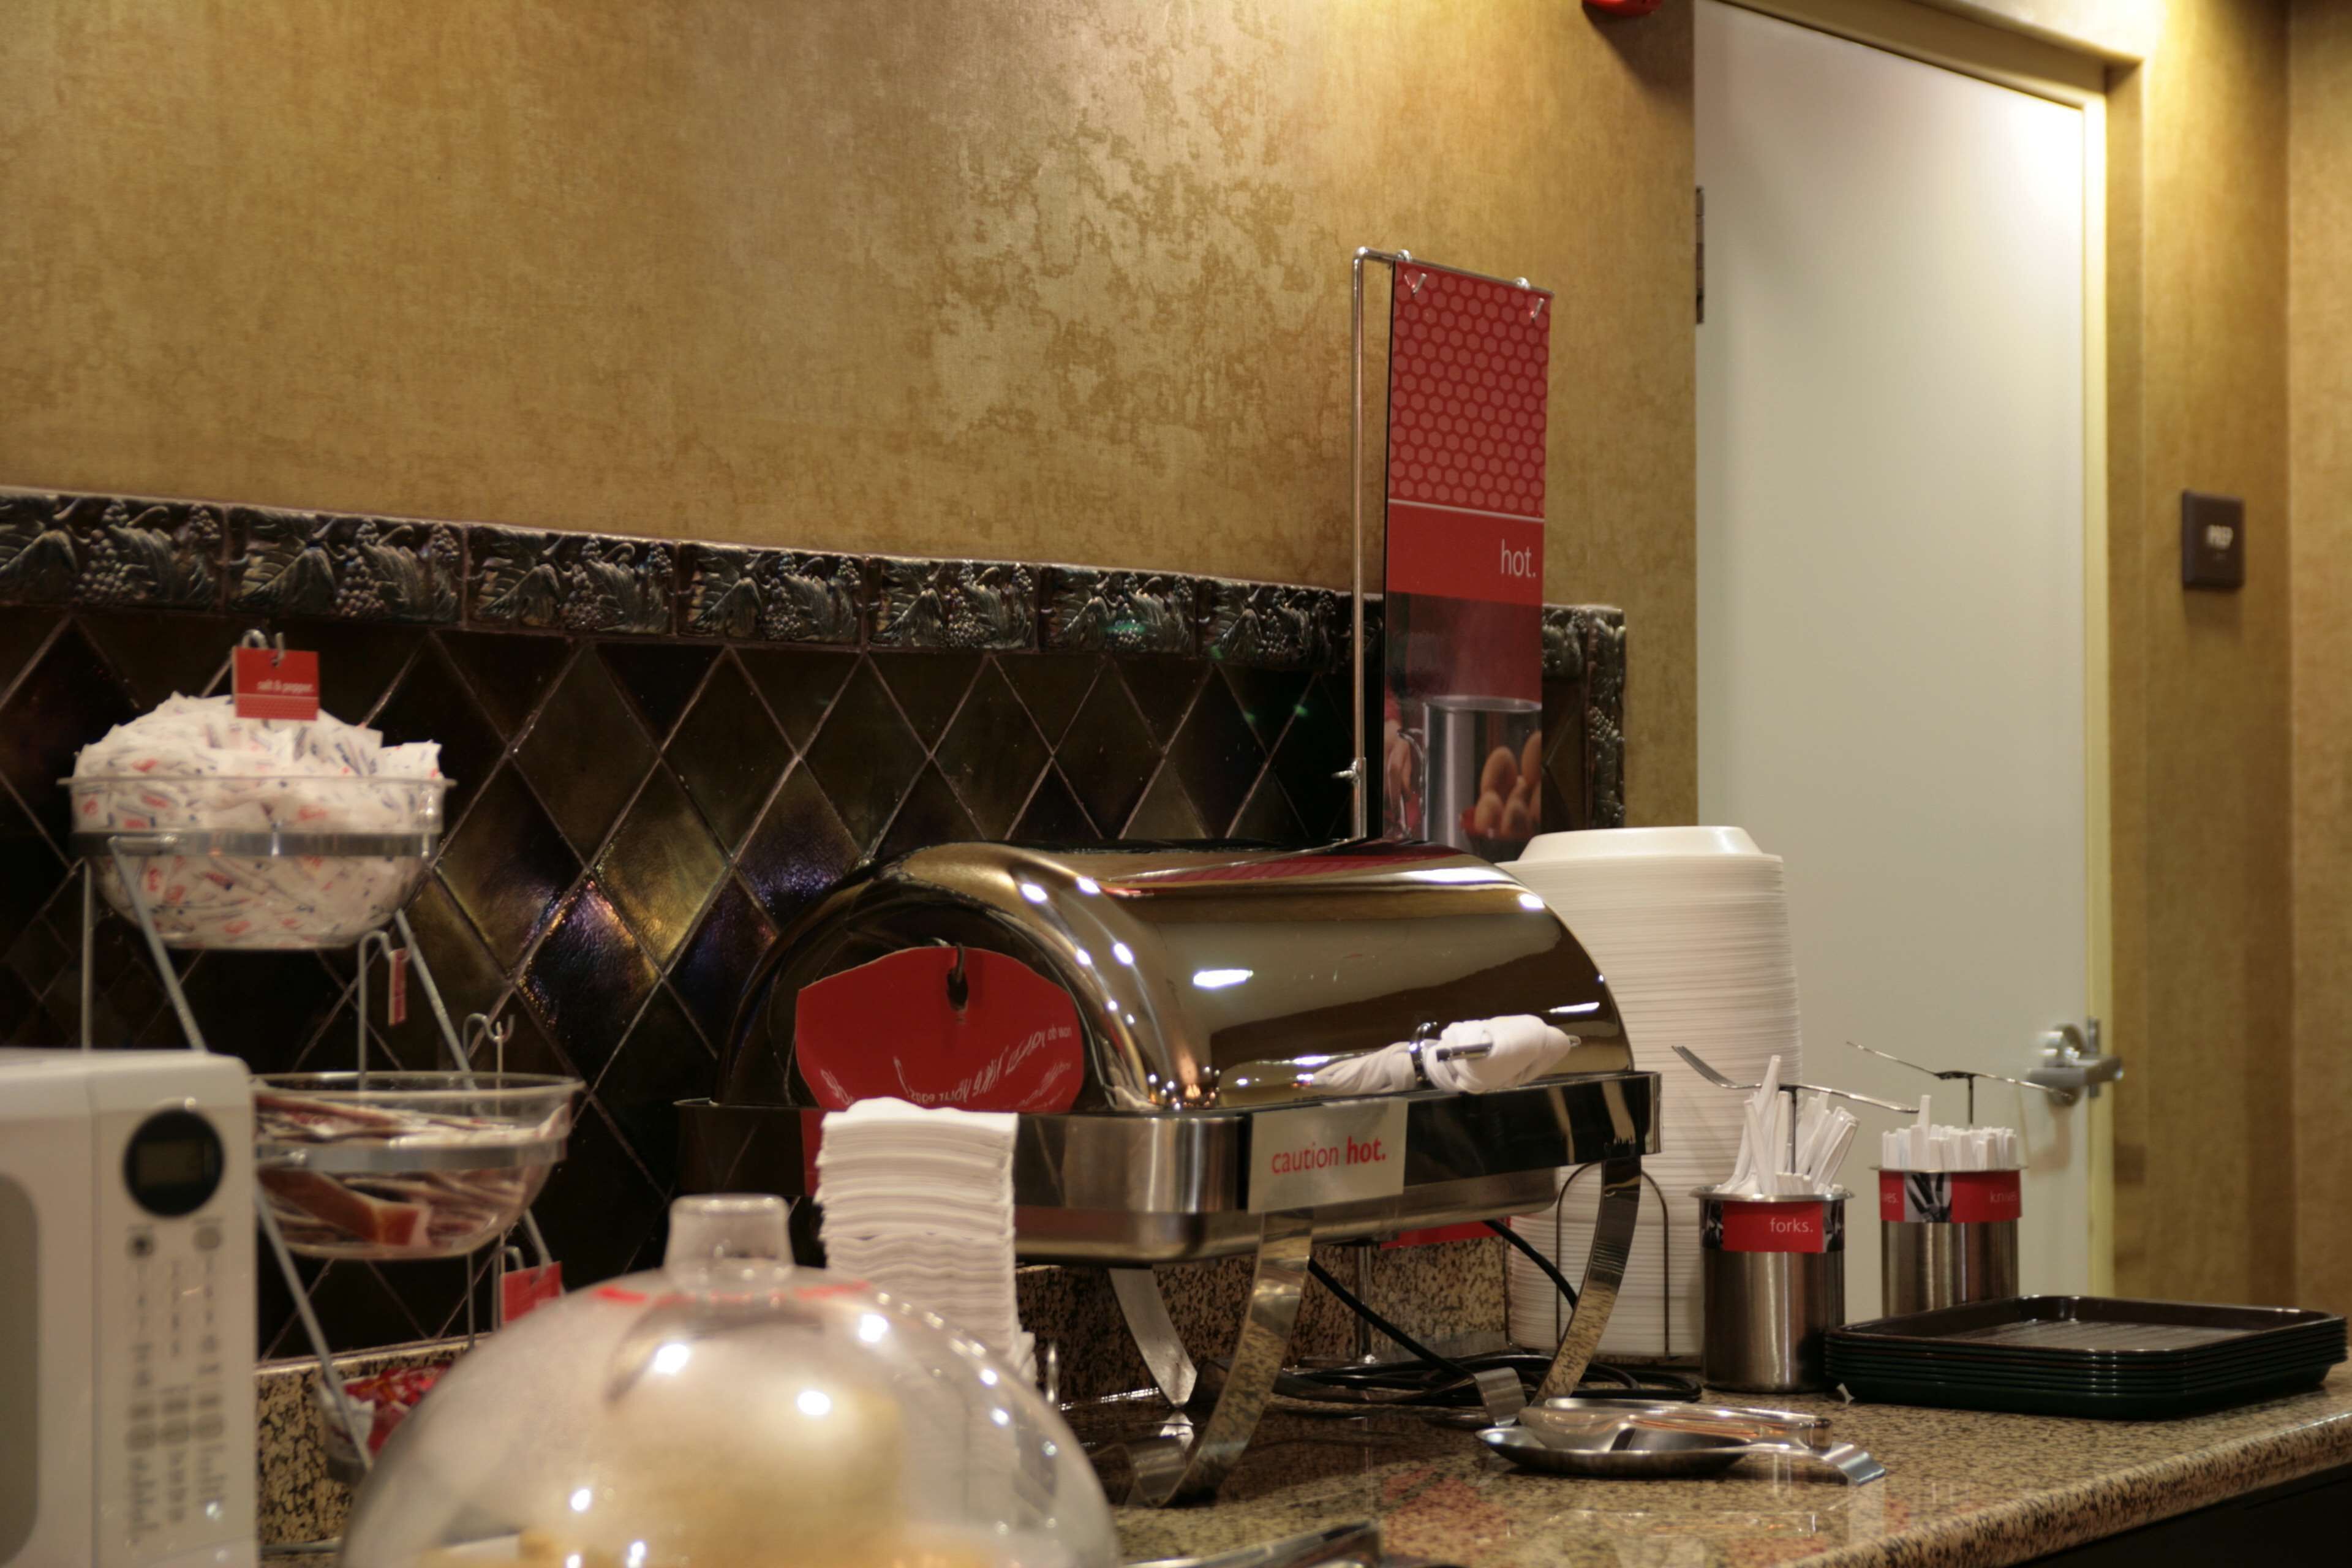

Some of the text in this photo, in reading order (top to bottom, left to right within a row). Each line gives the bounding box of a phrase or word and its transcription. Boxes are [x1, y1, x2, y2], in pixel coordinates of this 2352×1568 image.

[1501, 538, 1536, 577] hot.
[1271, 1135, 1387, 1174] caution hot.
[1769, 1216, 1814, 1233] forks.
